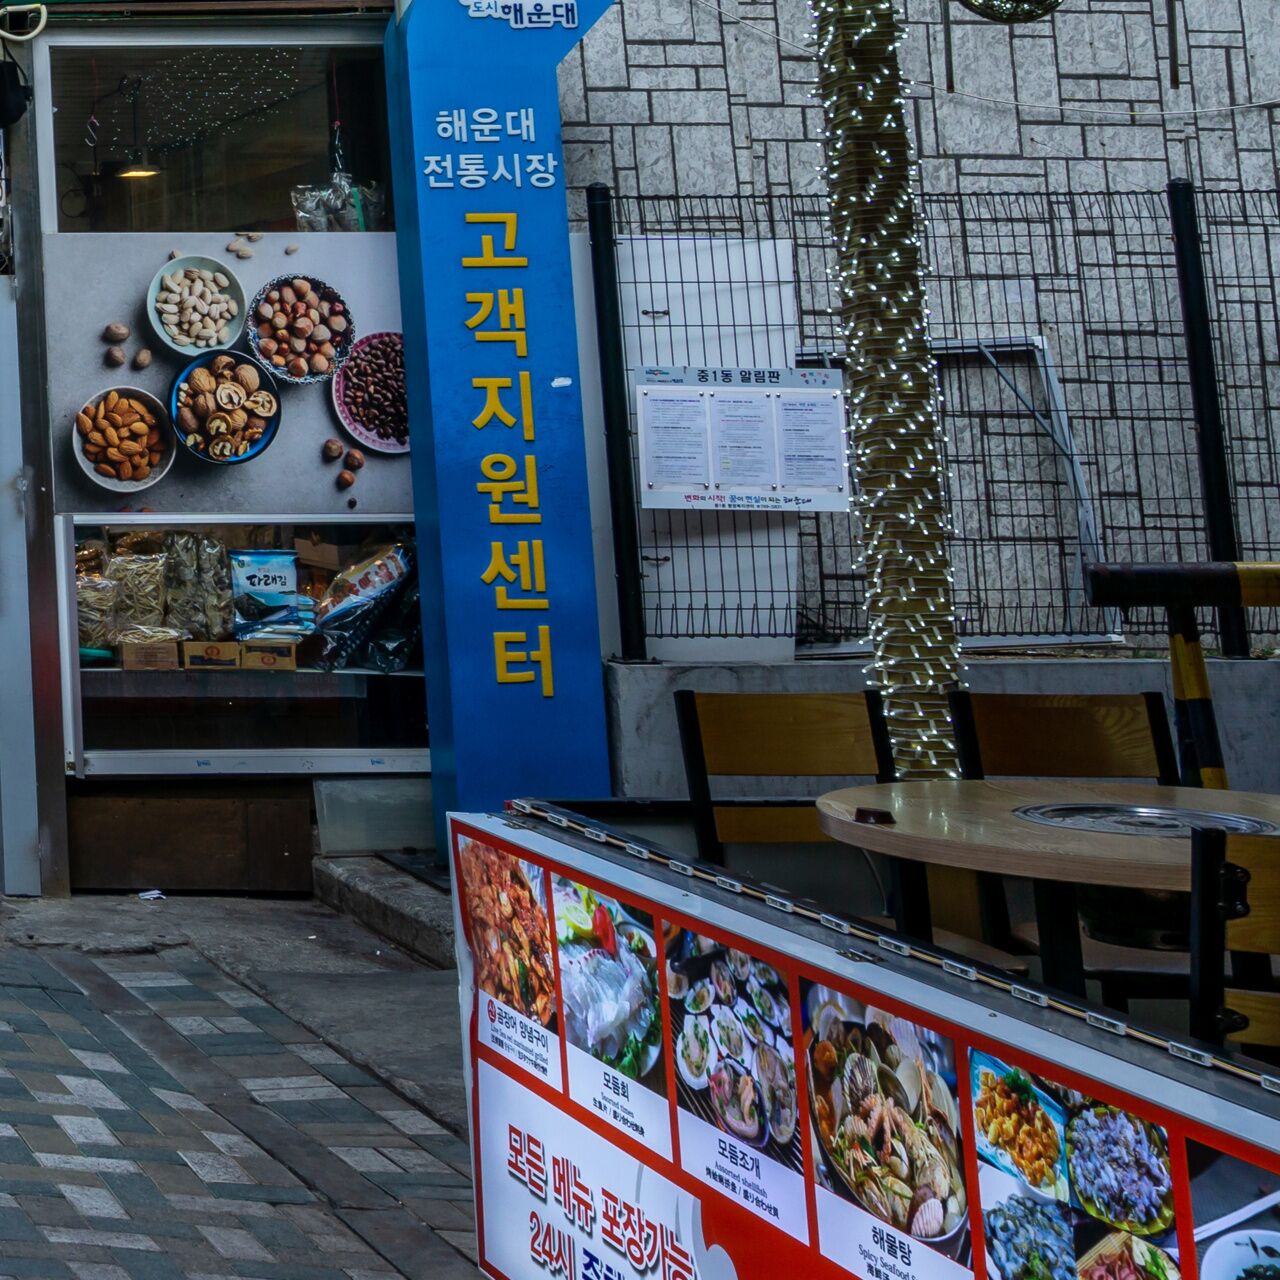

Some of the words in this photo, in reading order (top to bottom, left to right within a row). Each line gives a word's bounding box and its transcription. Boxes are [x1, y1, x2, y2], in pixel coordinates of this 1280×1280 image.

[472, 0, 498, 13] 도시
[501, 2, 576, 25] 해운대
[434, 106, 536, 145] 해운대
[421, 151, 559, 190] 전통시장
[697, 369, 734, 383] 중1동
[740, 369, 782, 384] 알림판
[460, 210, 557, 700] 고객지원센터
[245, 573, 288, 587] 파래김
[717, 1138, 761, 1181] 모듬조개
[507, 1123, 547, 1201] 모든
[552, 1155, 596, 1232] 메뉴
[600, 1185, 697, 1280] 포장가능
[871, 1225, 913, 1267] 해물탕
